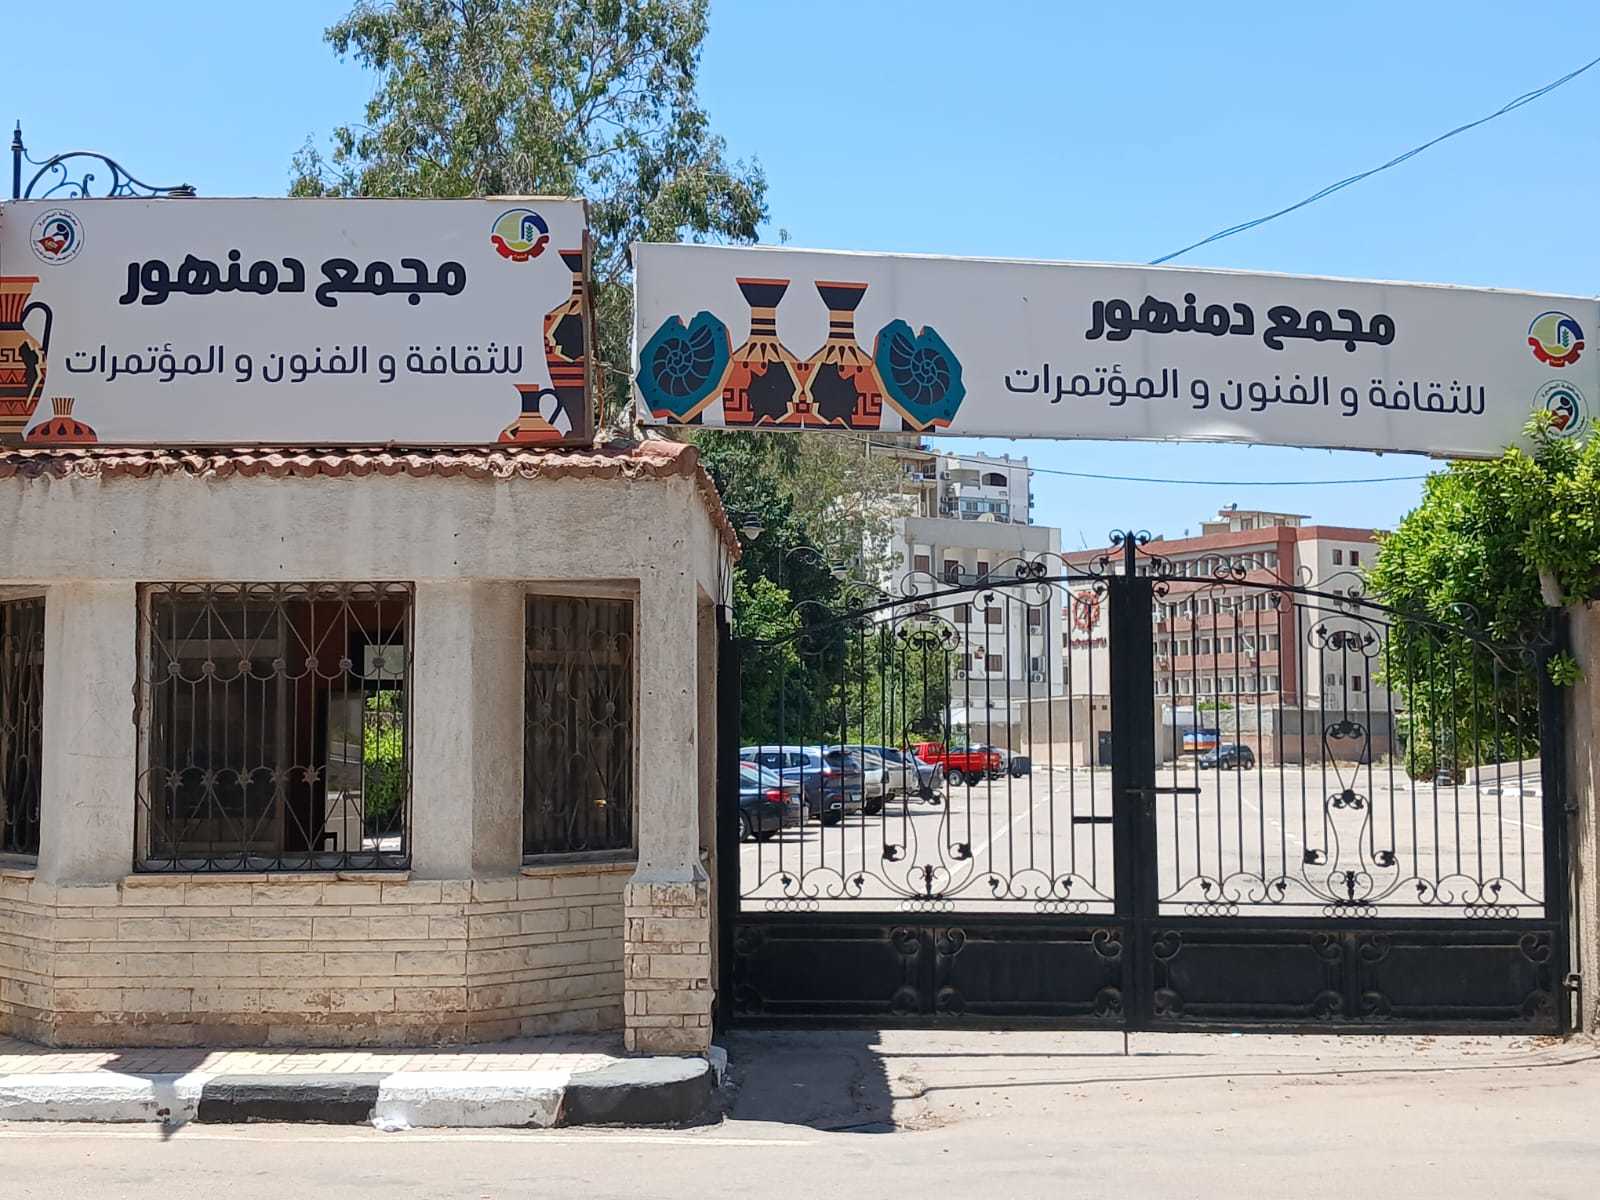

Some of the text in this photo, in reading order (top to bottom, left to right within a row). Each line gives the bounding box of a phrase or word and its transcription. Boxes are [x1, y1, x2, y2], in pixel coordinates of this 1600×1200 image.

[118, 249, 306, 305] دمنهور
[314, 257, 467, 309] مجمع
[1085, 292, 1397, 353] مجمع دمنهور
[65, 342, 523, 384] للثقافة و الفنون و المؤتمرات
[1004, 363, 1486, 418] للثقافة و الفنون و المؤتمرات
